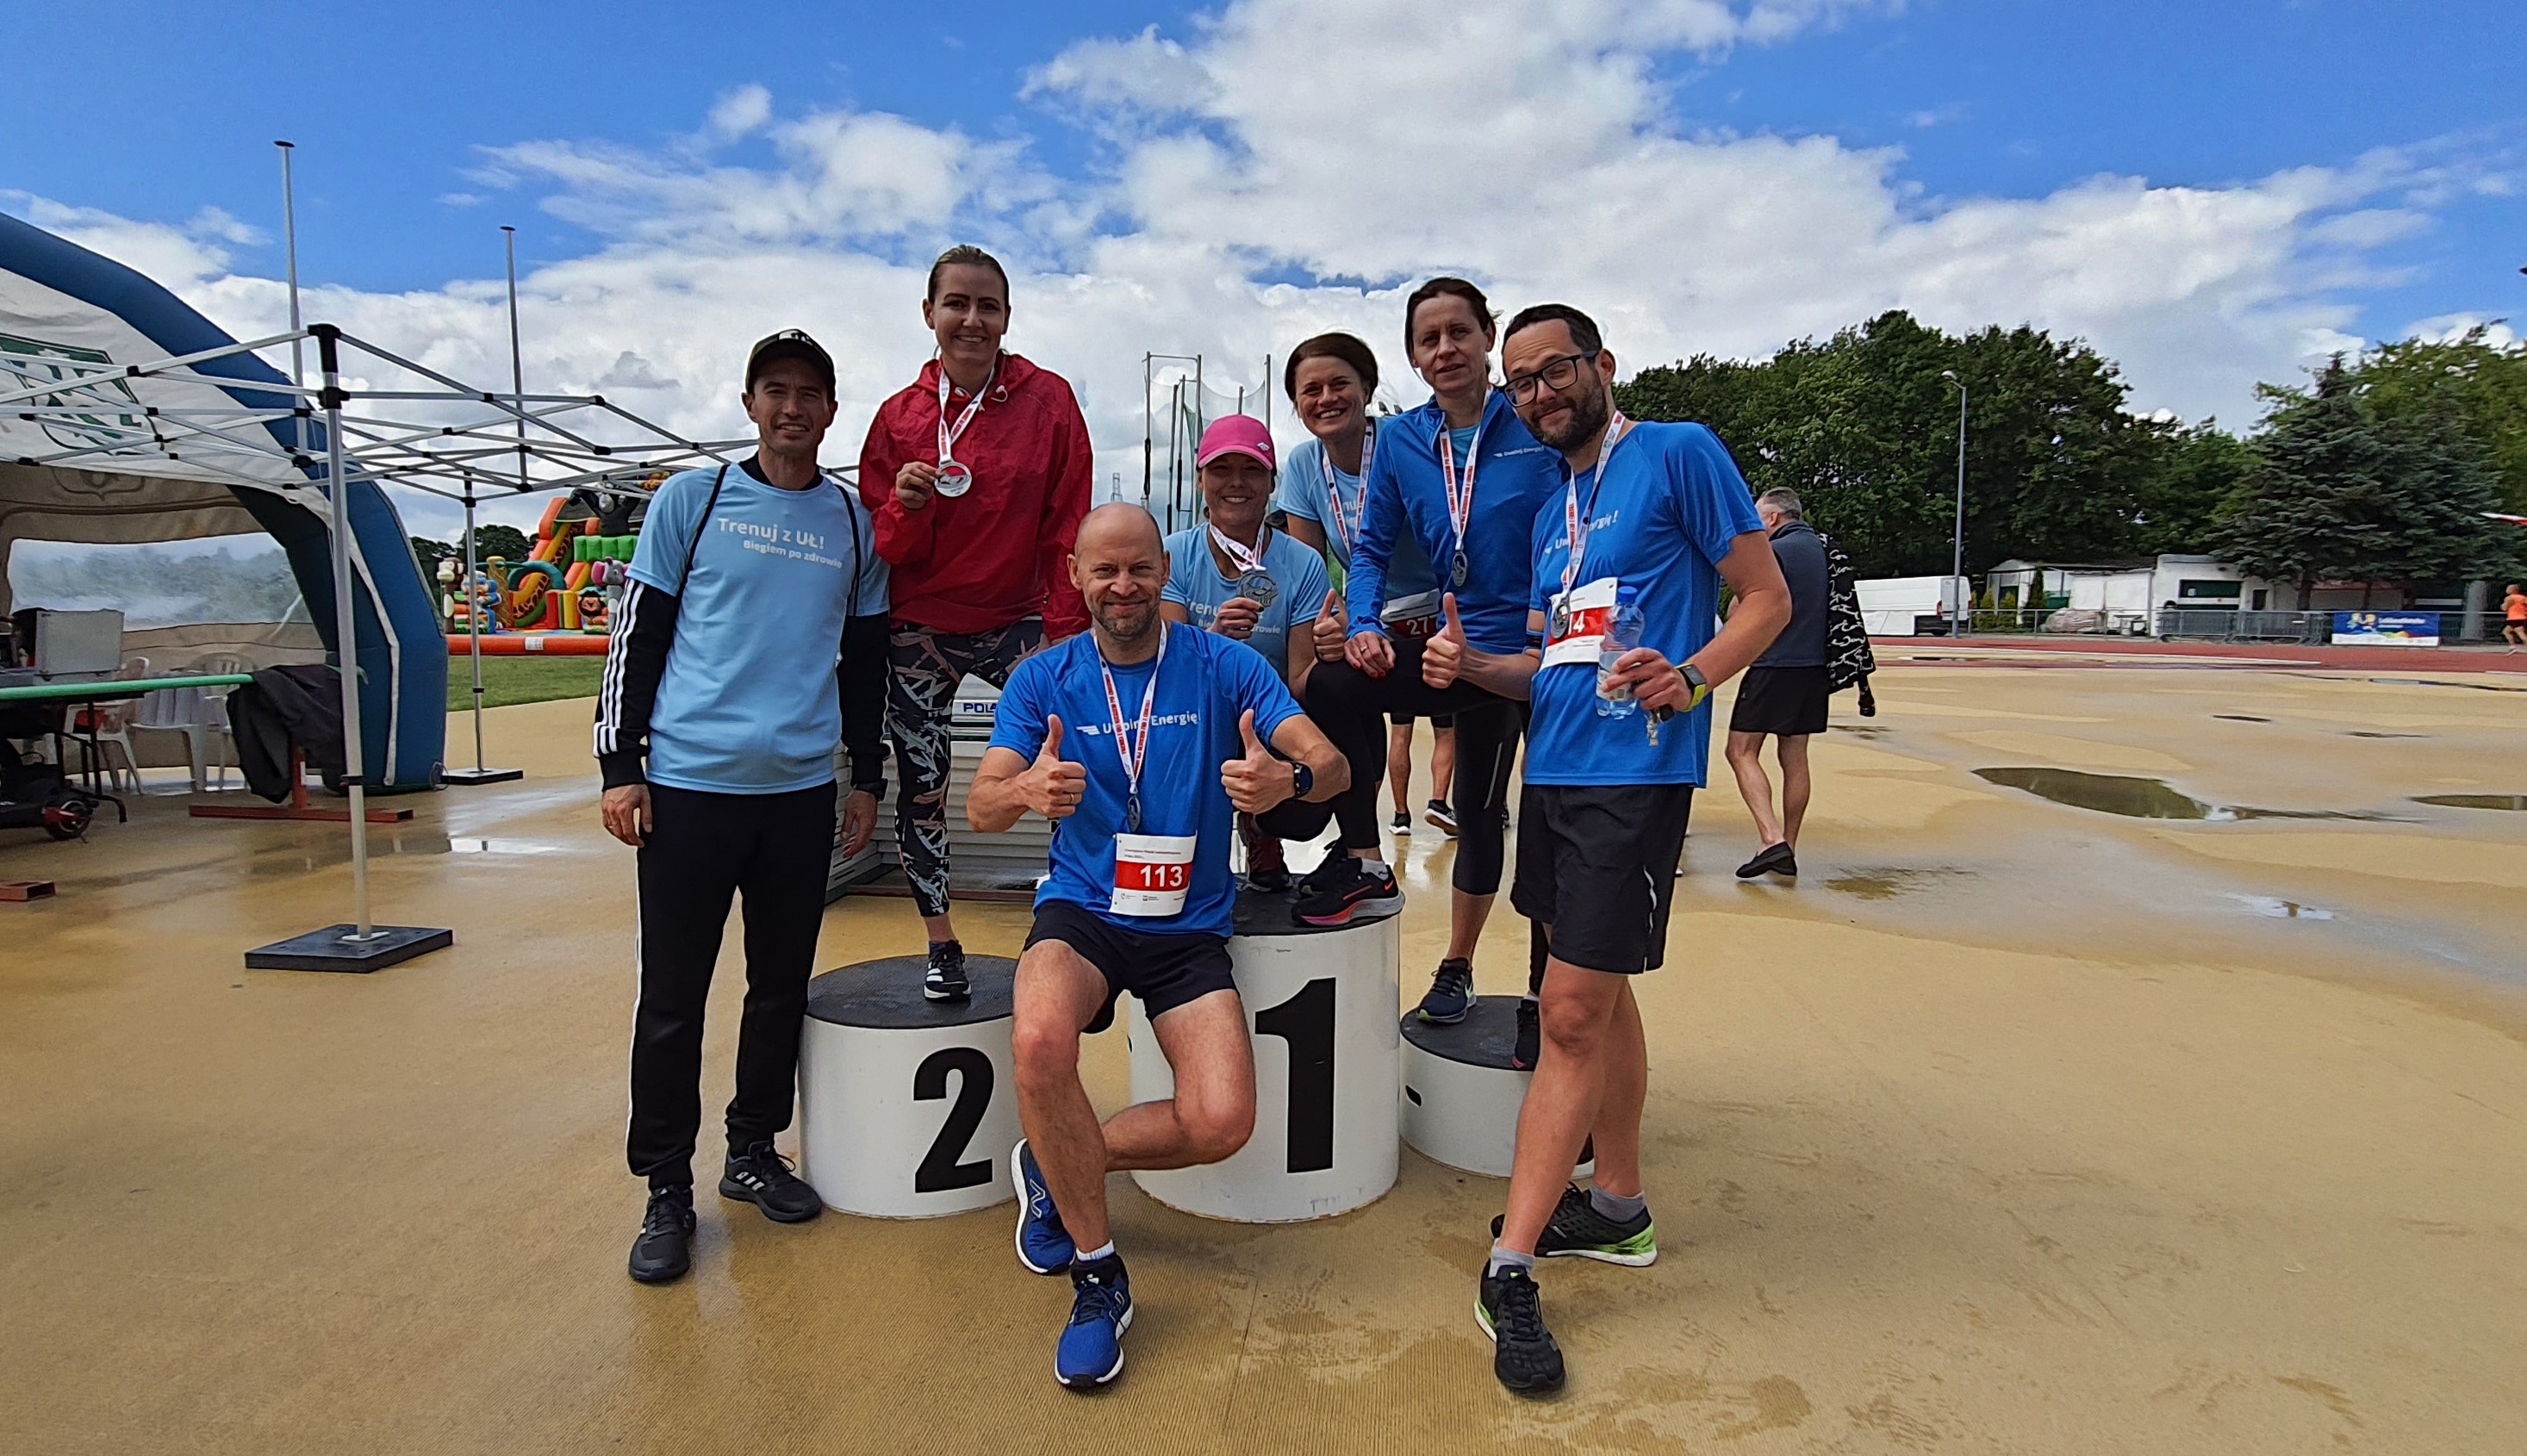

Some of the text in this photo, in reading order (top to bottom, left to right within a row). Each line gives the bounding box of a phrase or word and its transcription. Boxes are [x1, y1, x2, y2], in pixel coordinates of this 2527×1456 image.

[718, 518, 825, 549] Trenuj z UŁ!
[744, 539, 843, 569] Biegiem po zdrowie
[1188, 598, 1220, 615] renu
[1140, 864, 1183, 887] 113
[1254, 977, 1336, 1173] 1
[913, 1047, 994, 1193] 2
